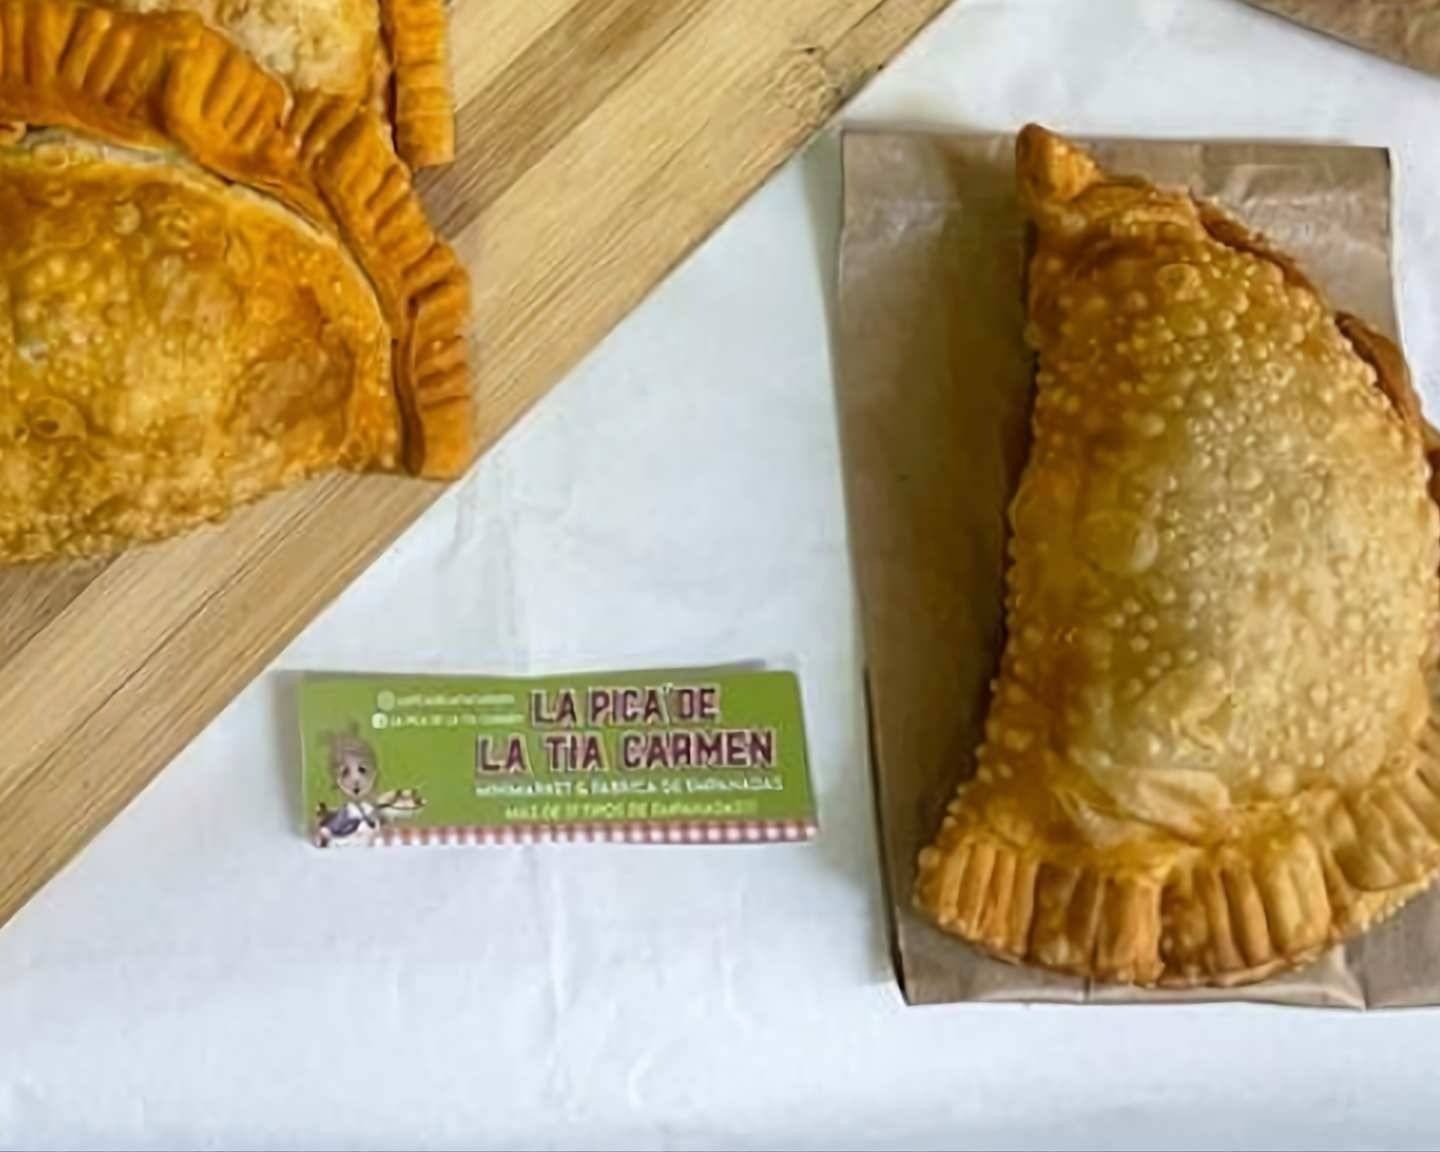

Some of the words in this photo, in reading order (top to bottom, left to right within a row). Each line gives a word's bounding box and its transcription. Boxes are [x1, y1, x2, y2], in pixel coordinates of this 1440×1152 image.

[530, 688, 581, 728] LA
[674, 686, 720, 723] DE
[476, 734, 528, 773] LA
[544, 730, 608, 772] TIA
[620, 727, 776, 769] CARMEN
